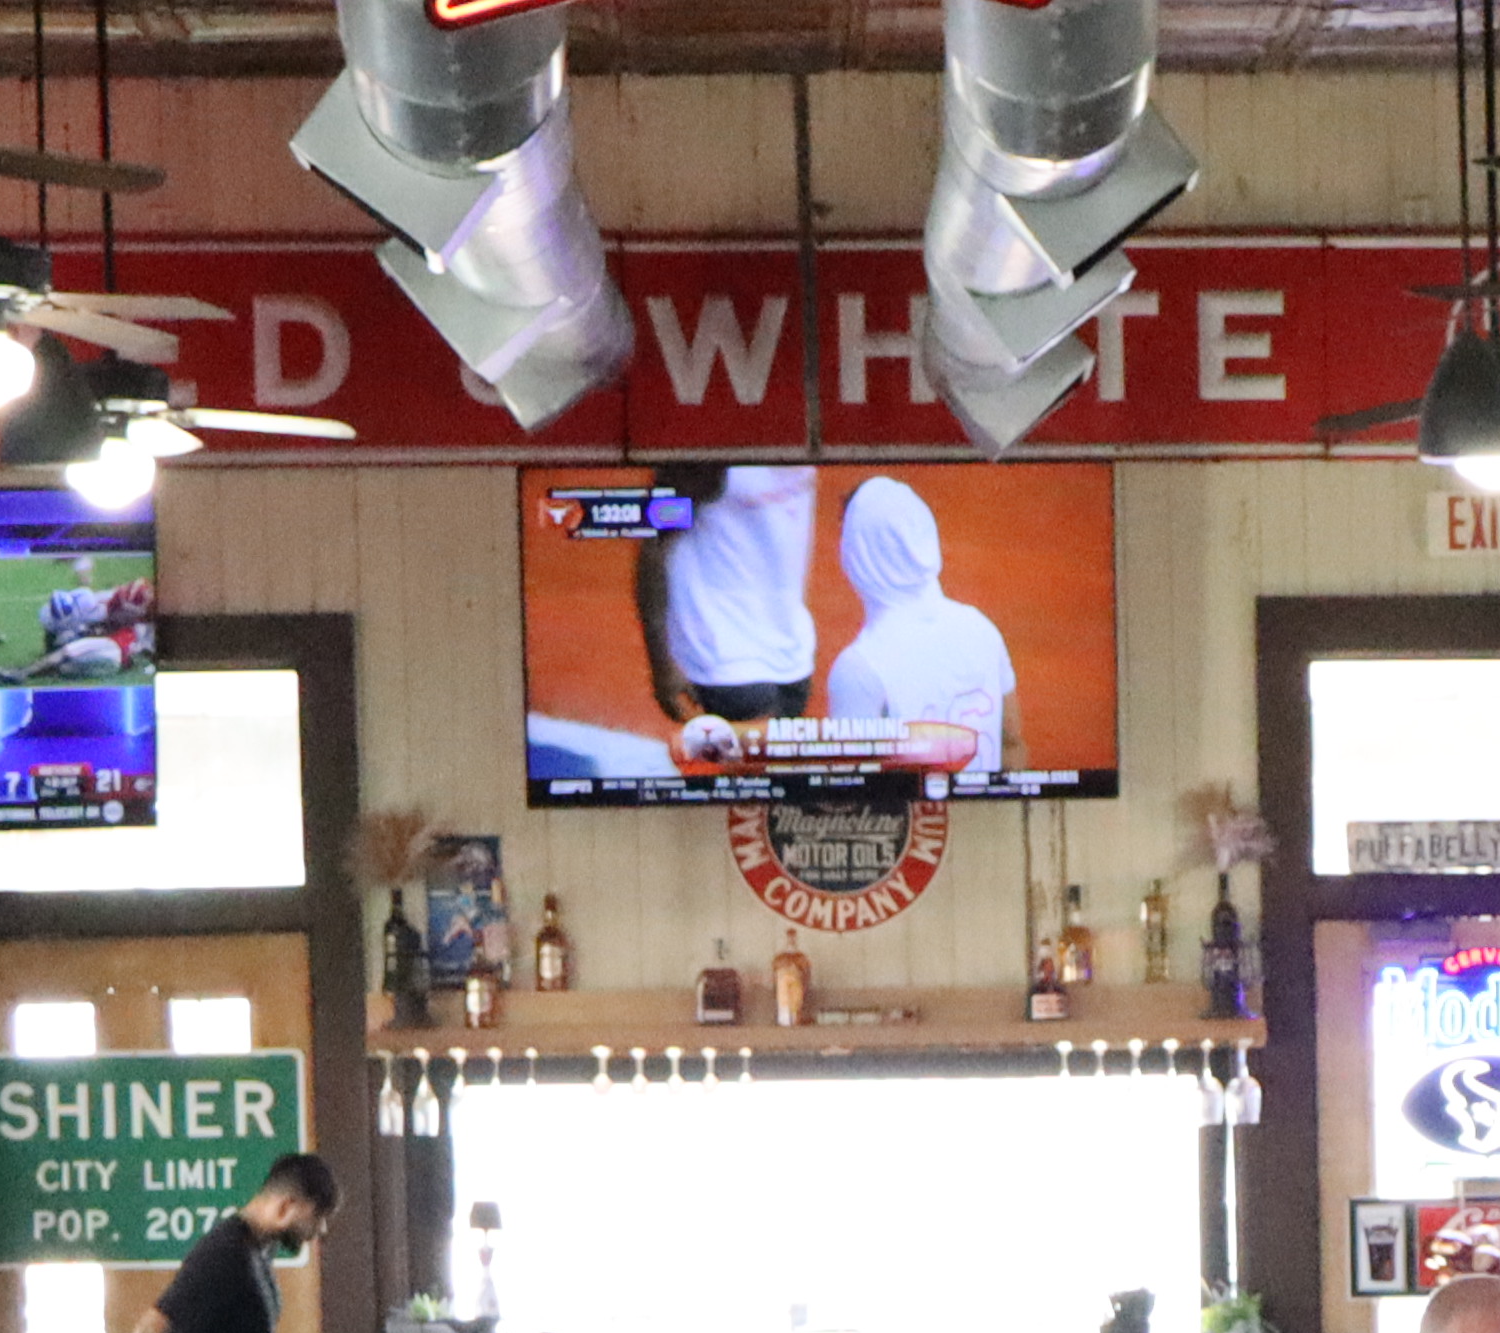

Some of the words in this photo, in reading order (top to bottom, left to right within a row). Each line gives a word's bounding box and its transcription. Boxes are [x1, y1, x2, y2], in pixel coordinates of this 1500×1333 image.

[646, 291, 1287, 405] WHTE
[767, 717, 819, 742] ARCH
[822, 717, 911, 742] MANNING
[4, 771, 21, 800] 7
[96, 768, 123, 793] 21
[782, 841, 847, 868] MOTOR
[852, 841, 897, 867] OILS
[763, 869, 916, 931] COMPANY
[36, 1160, 117, 1193] CITY
[144, 1158, 238, 1191] LIMIT
[32, 1209, 120, 1242] POP.
[146, 1206, 241, 1241] 207
